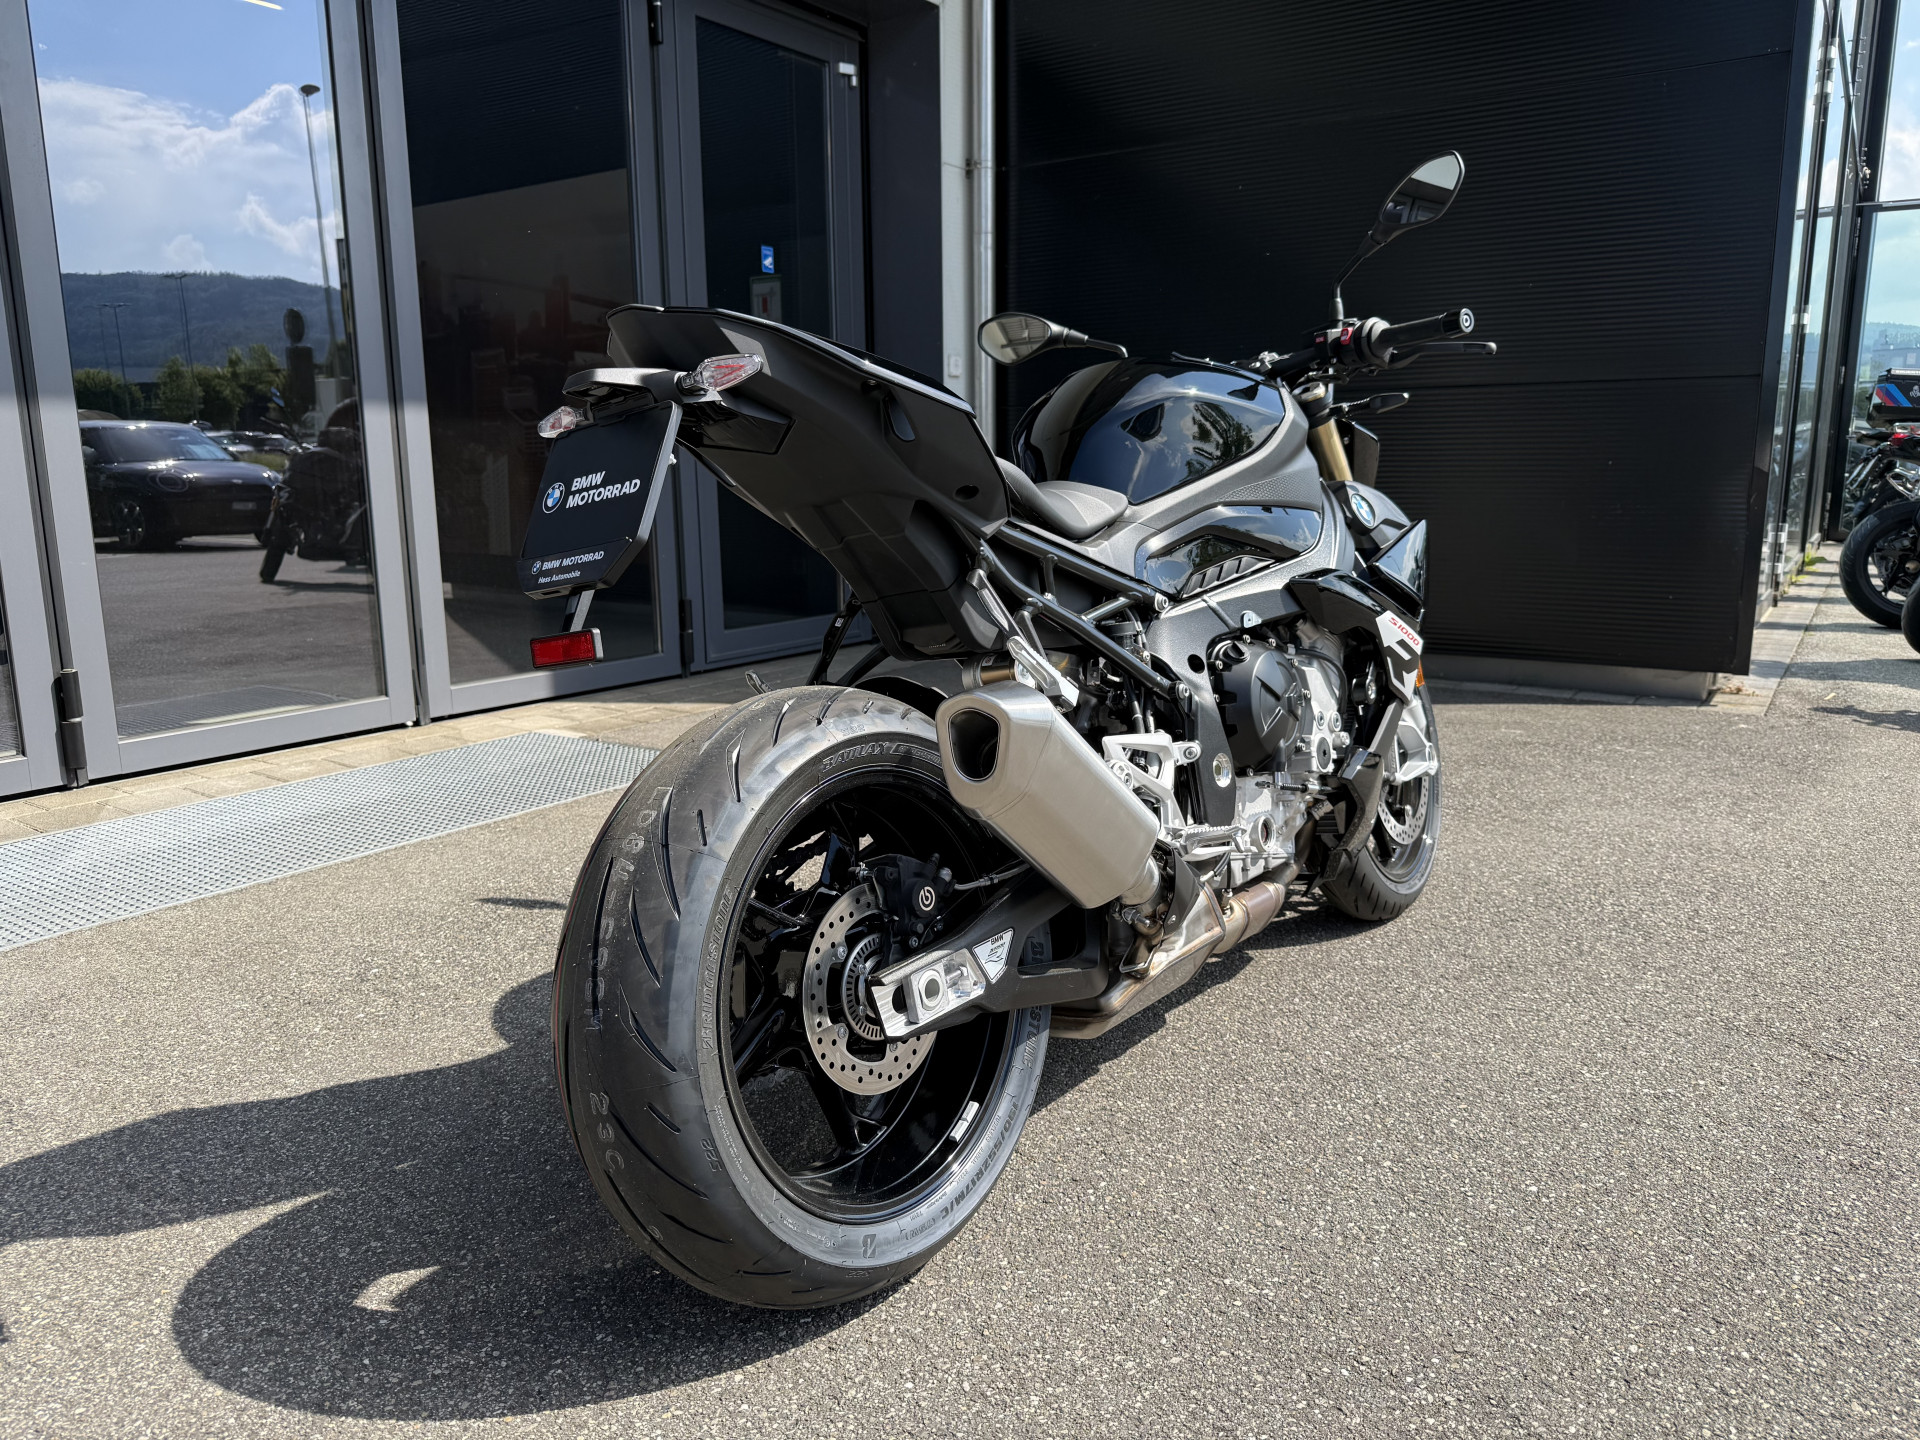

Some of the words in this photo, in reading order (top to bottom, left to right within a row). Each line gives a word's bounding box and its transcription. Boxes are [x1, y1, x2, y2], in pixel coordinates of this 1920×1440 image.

[571, 471, 606, 491] BMW
[566, 479, 640, 509] MOTORRAD
[542, 559, 562, 571] BMW
[562, 551, 605, 567] MOTORRAD
[551, 570, 581, 581] Automobile
[990, 935, 1004, 946] BMW
[702, 888, 733, 1050] BRIDGESTONE
